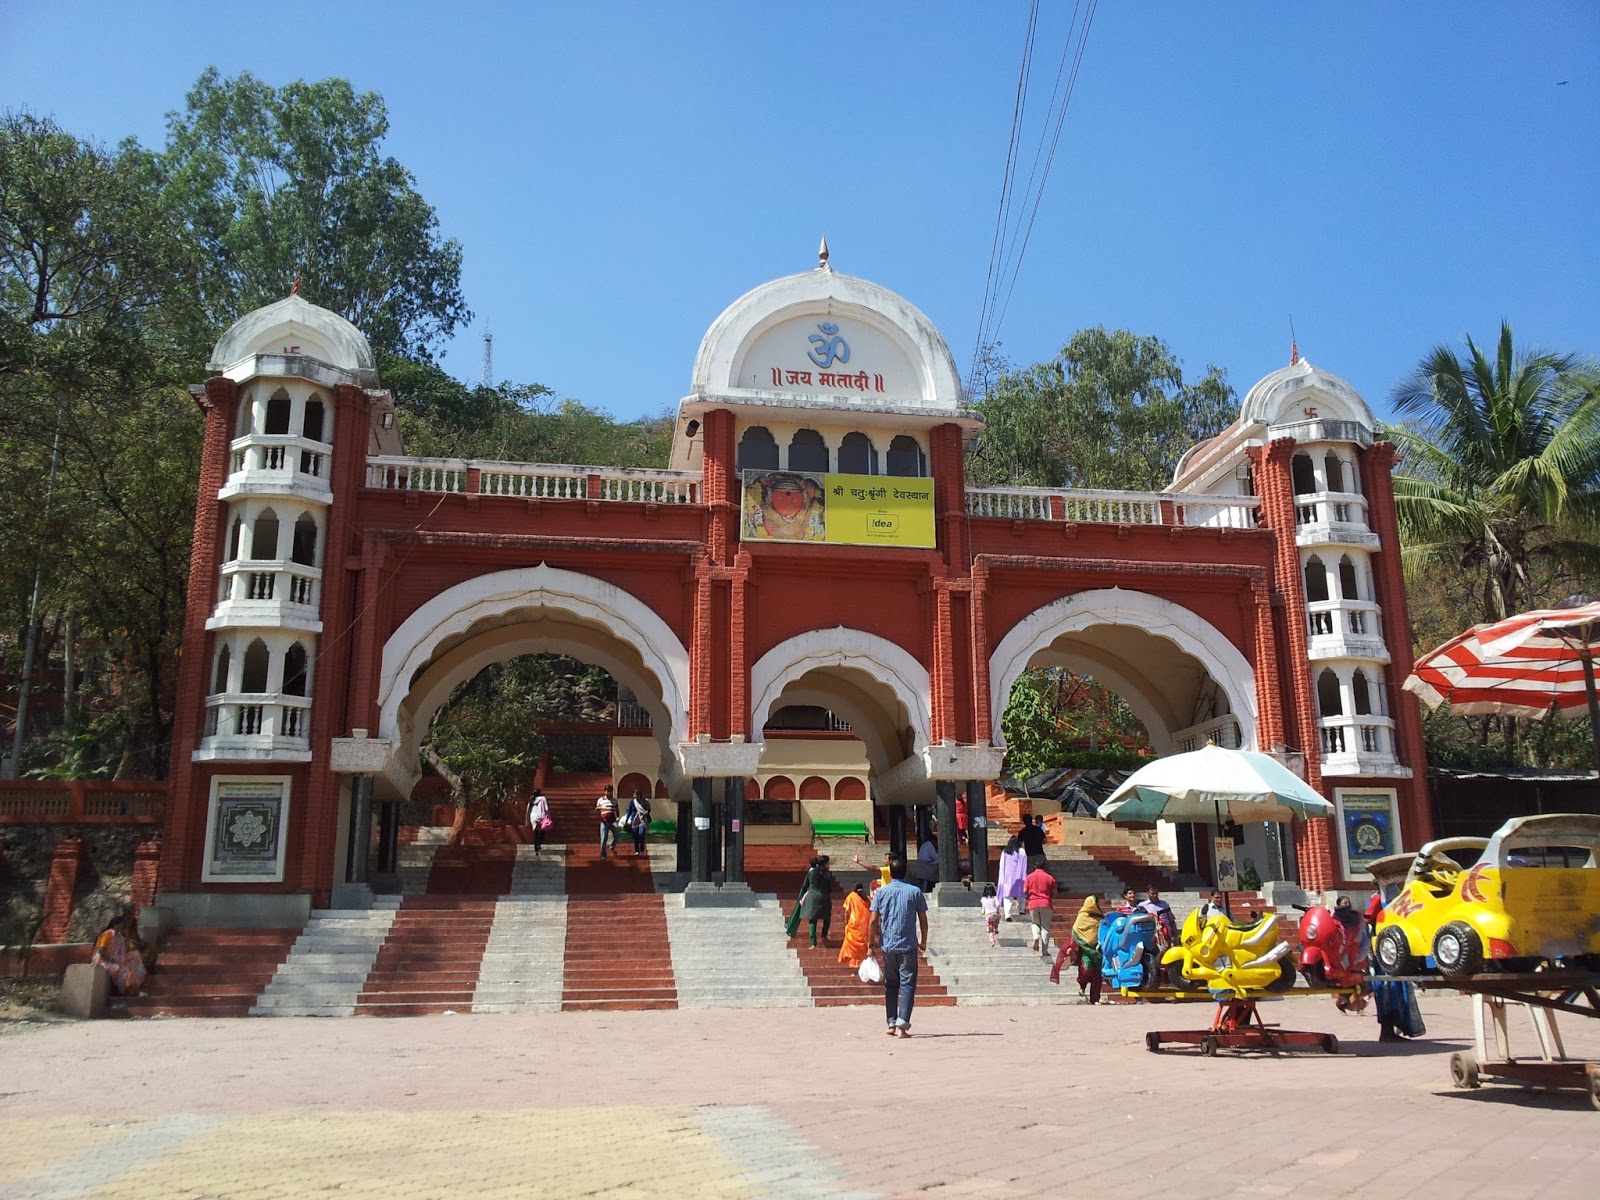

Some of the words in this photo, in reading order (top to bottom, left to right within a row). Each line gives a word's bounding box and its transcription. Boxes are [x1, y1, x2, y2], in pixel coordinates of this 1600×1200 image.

[785, 370, 813, 387] जय
[818, 370, 870, 392] मातादी
[832, 485, 844, 497] श्री
[893, 488, 930, 501] देवस्थान
